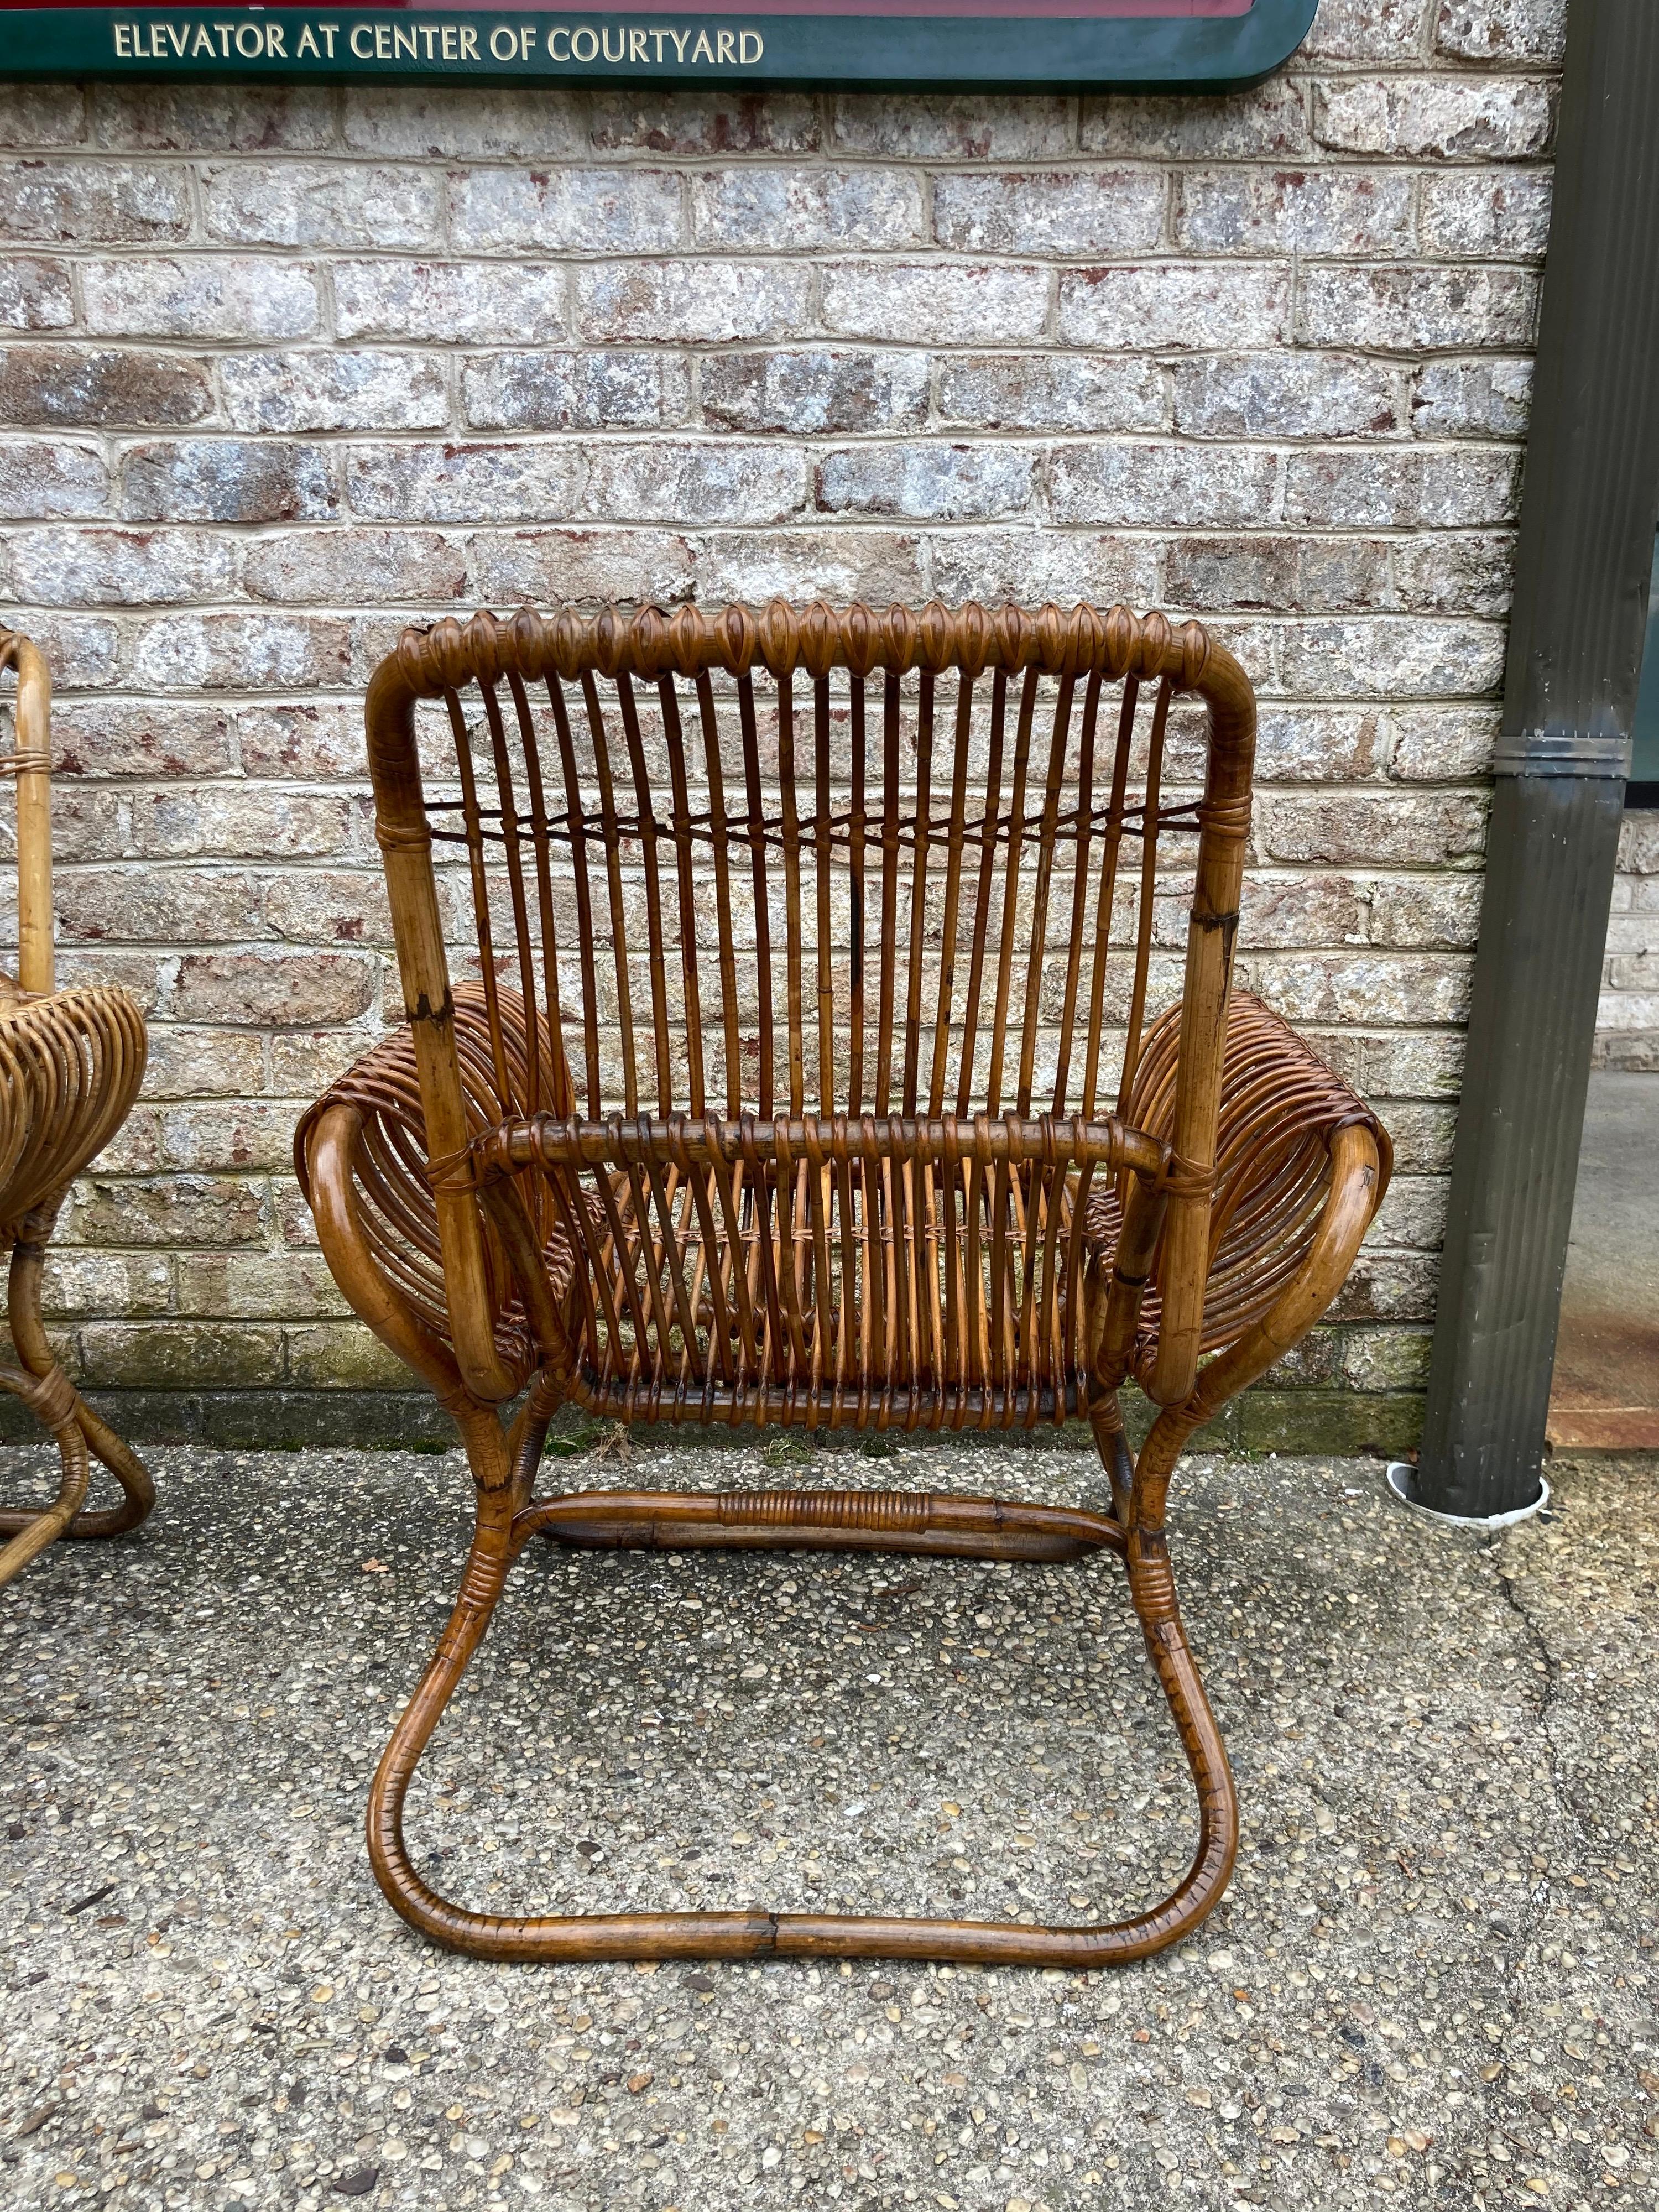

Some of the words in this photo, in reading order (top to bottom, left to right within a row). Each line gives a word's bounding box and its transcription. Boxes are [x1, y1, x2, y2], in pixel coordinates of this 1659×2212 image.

[114, 23, 288, 58] ELEVATOR
[296, 24, 339, 58] AT
[350, 24, 481, 60] CENTER
[489, 25, 536, 61] OF
[547, 25, 764, 64] COURTYARD
